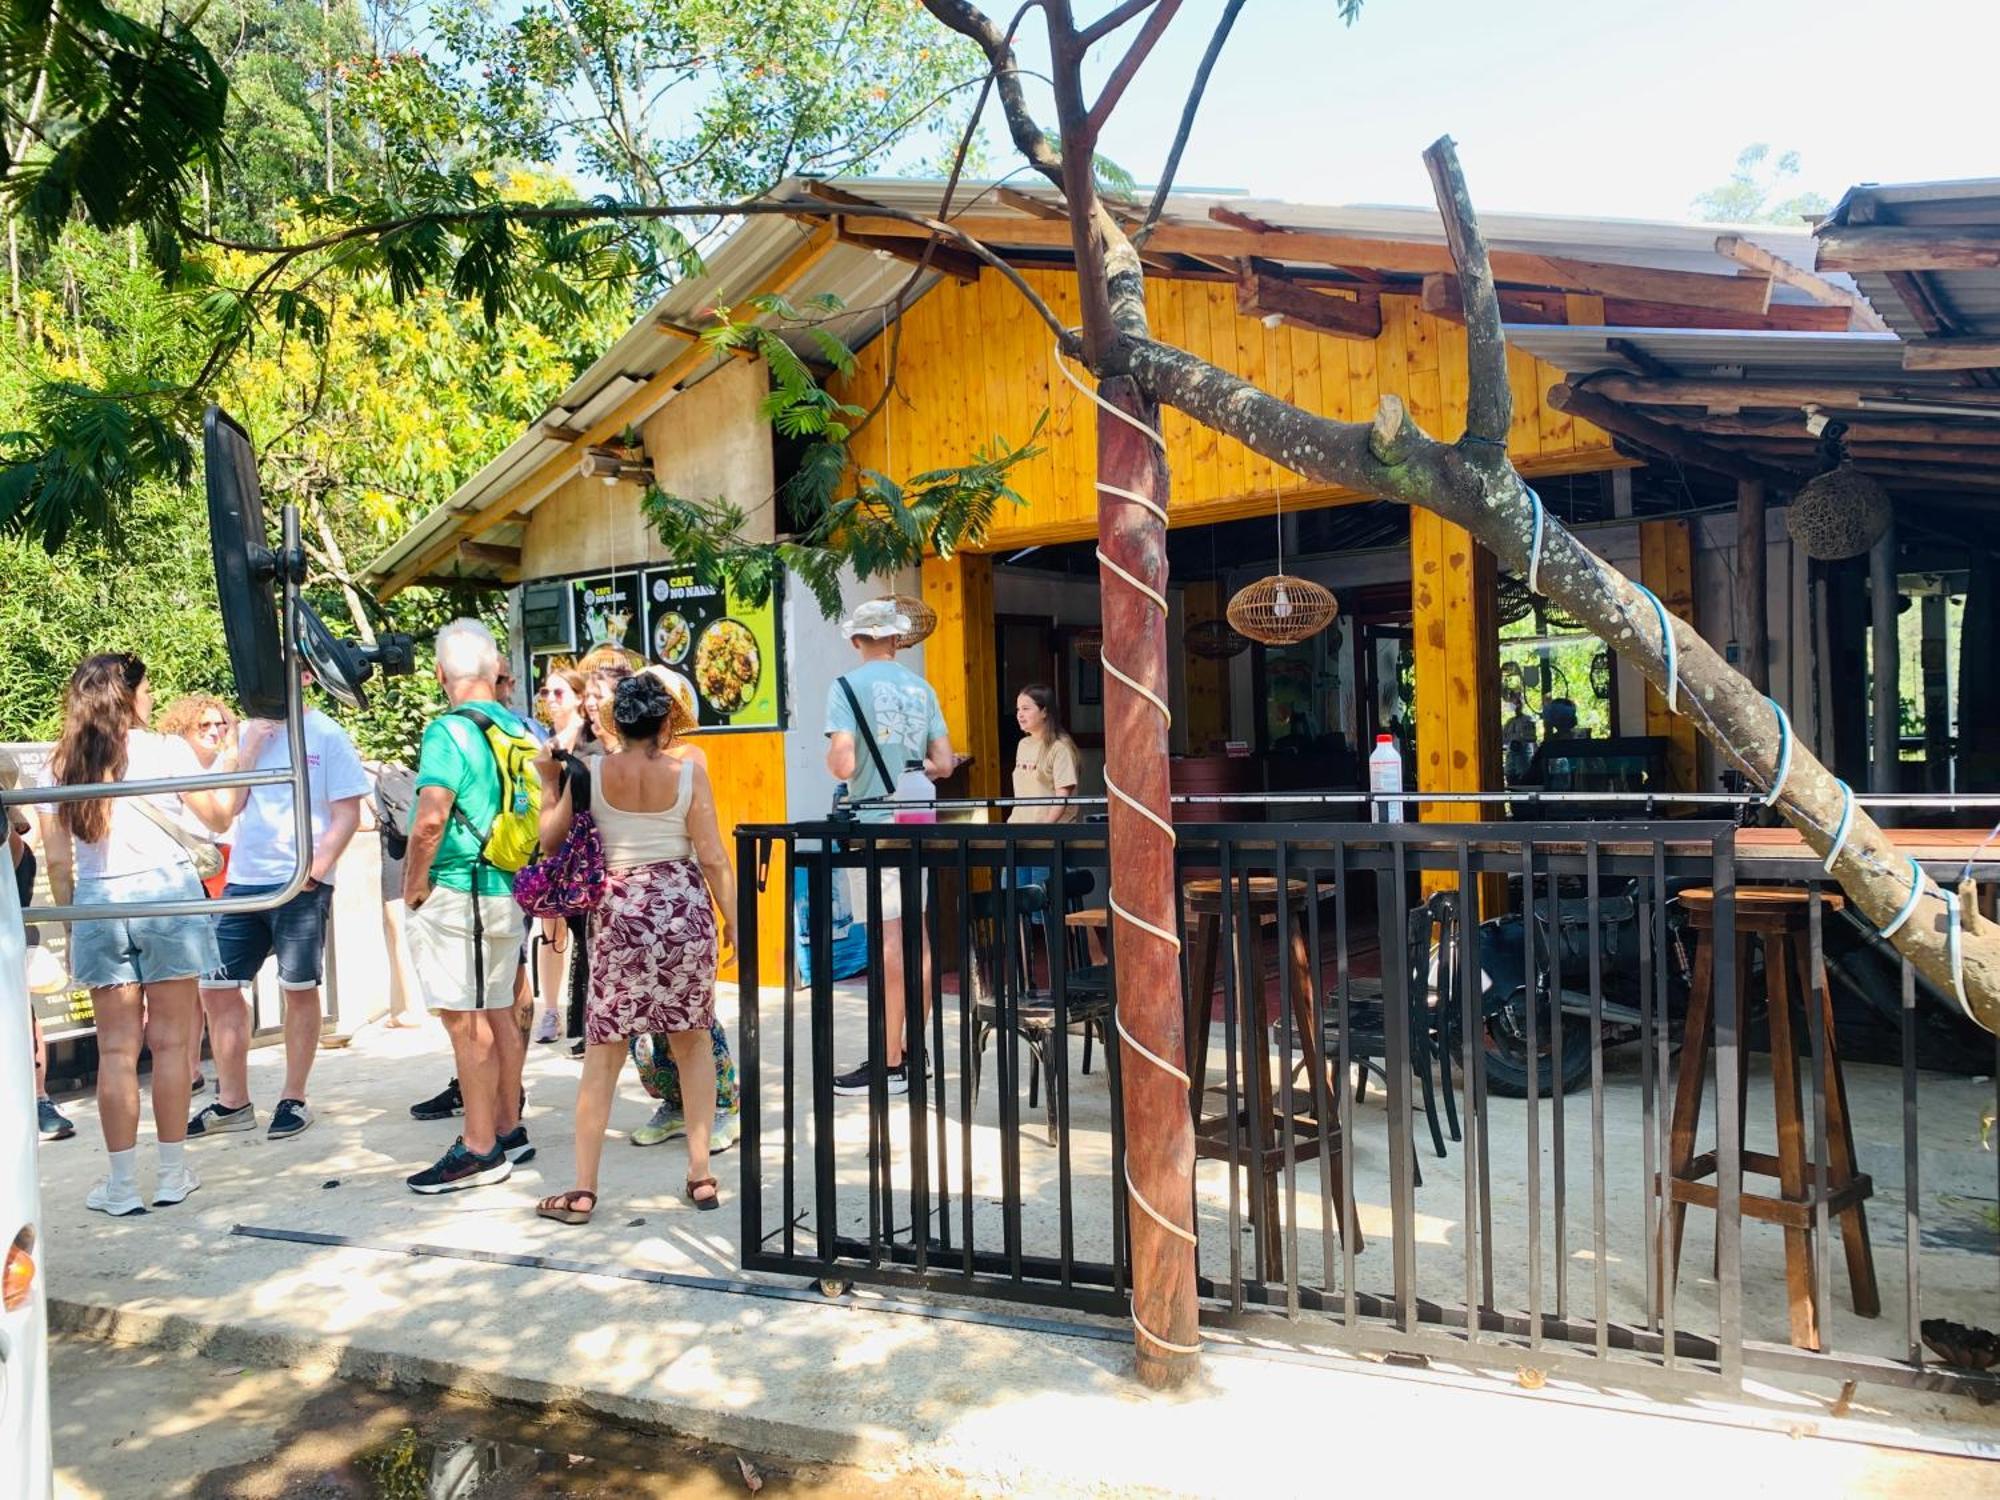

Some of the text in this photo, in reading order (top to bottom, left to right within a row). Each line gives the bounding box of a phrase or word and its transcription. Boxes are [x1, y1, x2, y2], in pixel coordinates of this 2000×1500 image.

[669, 576, 694, 588] CAFE
[595, 586, 612, 596] CAFE
[670, 587, 685, 600] NO
[595, 595, 605, 605] NO
